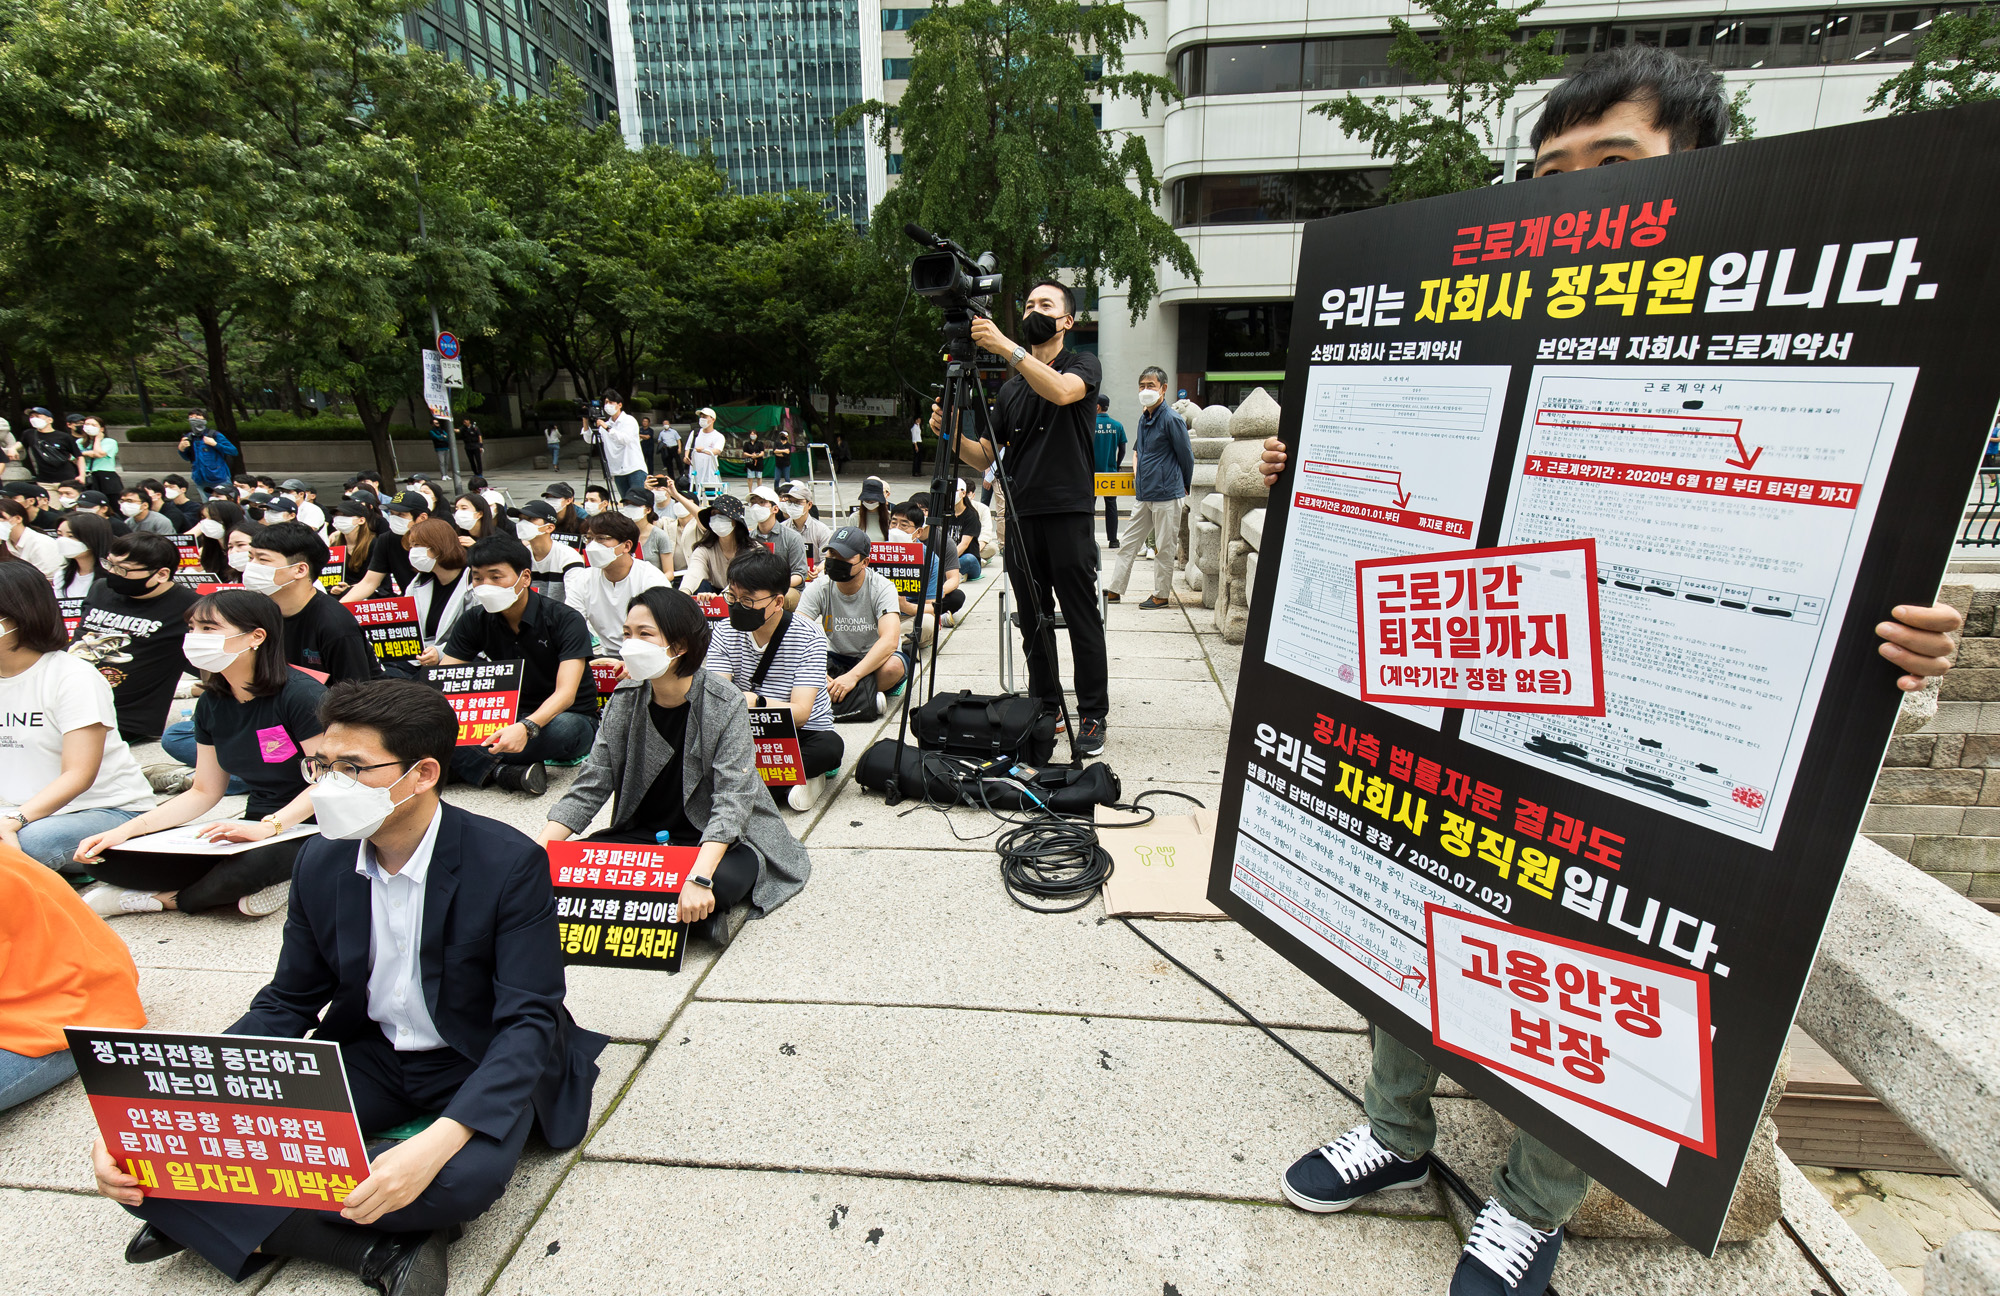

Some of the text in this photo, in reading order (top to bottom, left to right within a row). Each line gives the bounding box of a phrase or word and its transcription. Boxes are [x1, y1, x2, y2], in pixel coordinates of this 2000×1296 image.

[1452, 198, 1677, 266] 근로계약서상
[1319, 237, 1939, 330] 우리는 자회사 정직원입니다.
[1310, 340, 1462, 361] 소방대 자회사 근로계약서
[1536, 332, 1854, 361] 보안검색 자회사 근로계약서
[1097, 480, 1116, 489] ICE
[1530, 460, 1544, 472] 가.
[1547, 461, 1615, 480] 근로계약기간
[1625, 467, 1673, 486] 2020년
[1676, 474, 1700, 488] 6월
[1705, 477, 1728, 490] 1일
[1732, 479, 1762, 494] 부터
[1766, 481, 1814, 499] 퇴직일
[1818, 486, 1853, 503] 까지
[1298, 495, 1465, 534] 근로계약기간은 2020.01.01.부터 까지로 한다.
[879, 554, 900, 562] 직고용
[901, 554, 915, 562] 거부
[892, 568, 920, 577] 합의이행
[888, 579, 921, 592] 임져라!
[1377, 564, 1523, 614] 근로기간
[85, 608, 163, 633] SNEAKERS
[355, 601, 398, 613] 가정파탄내는
[371, 613, 393, 622] 직고용
[395, 611, 409, 620] 거부
[371, 626, 418, 640] 전환 합의이행
[834, 623, 877, 632] GEOGRAPHIC
[1379, 614, 1569, 660] 퇴직일까지
[372, 640, 422, 658] 이 책임져라!
[428, 664, 514, 681] 정규직전환 중단하고
[443, 679, 495, 692] 재논의 하라!
[1380, 665, 1572, 696] (계약기간 정함 없음)
[455, 708, 510, 722] 통령 때문에
[468, 696, 505, 709] 찾아왔던
[761, 754, 794, 765] 때문에
[1313, 712, 1626, 871] 공사측 법률자문 결과도
[1247, 761, 1512, 913] 법률자문 답변(법무법인 광장 / 2020.07.02)
[1254, 722, 1731, 978] 우리는 자회사 정직원입니다.
[580, 848, 664, 868] 가정파탄내는
[558, 866, 679, 888] 일방적 직고용 거부
[1338, 855, 1361, 877] 유지할
[1364, 872, 1389, 894] 의무를
[1387, 865, 1404, 882] 중인
[1410, 879, 1447, 905] 근로자가
[554, 896, 679, 924] 회사 전환 합의이행
[604, 924, 678, 959] 책임져라!
[1461, 934, 1663, 1039] 고용안정
[90, 1039, 322, 1077] 정규직전환 중단하고
[1510, 1007, 1610, 1085] 보장
[144, 1070, 284, 1100] 재논의 하라!
[126, 1107, 327, 1142] 인천공항 찾아왔던
[118, 1132, 350, 1168] 문재인 대통령 때문에
[125, 1158, 358, 1203] 내 일자리 개박살
